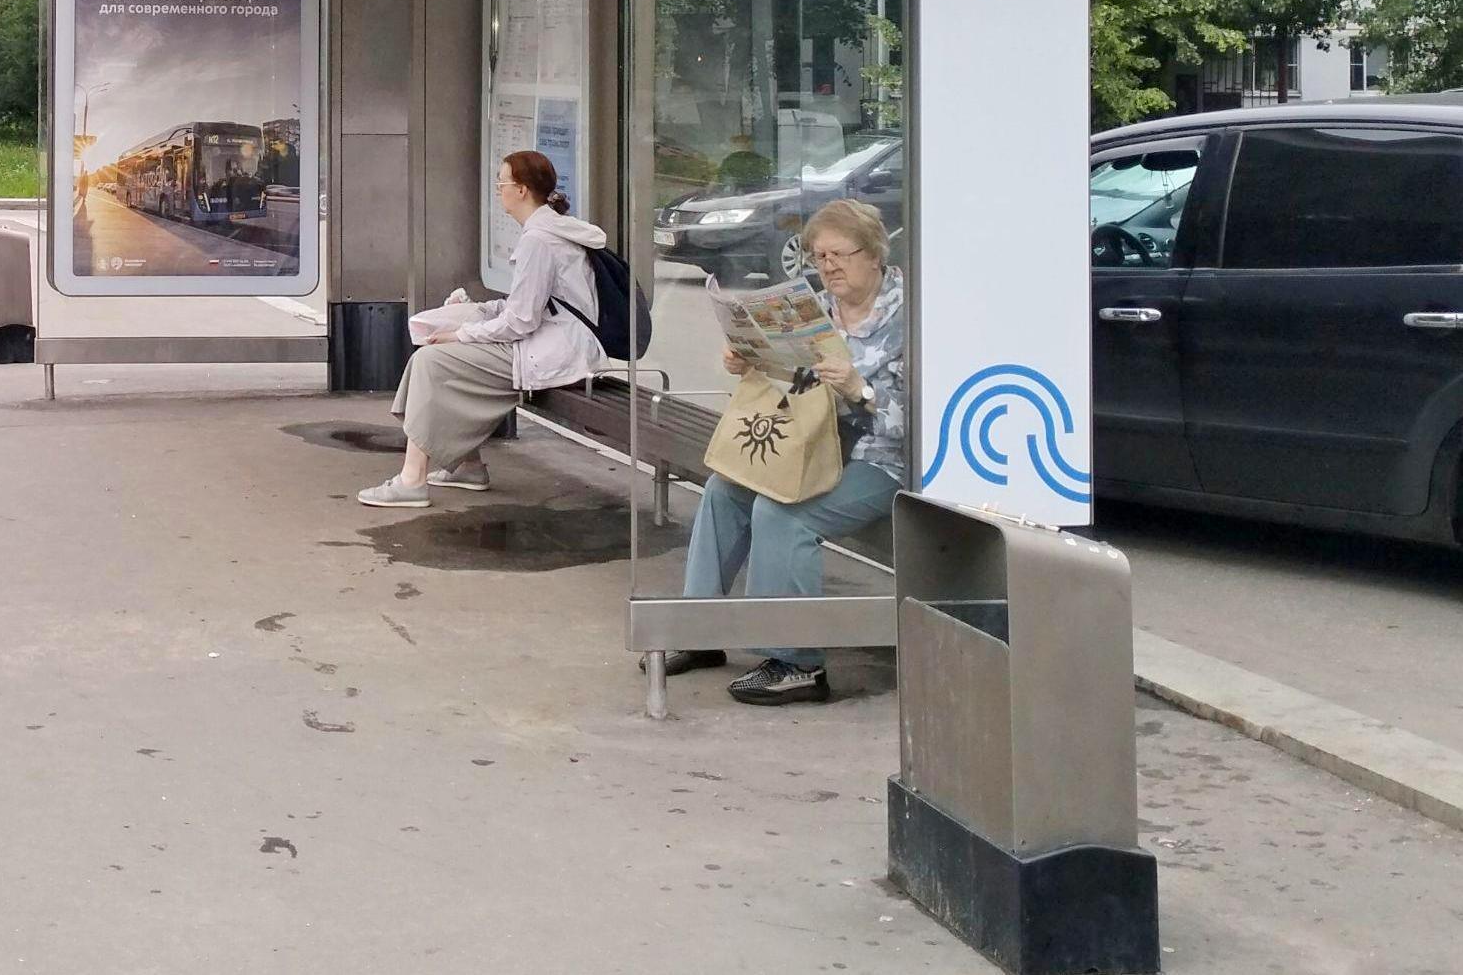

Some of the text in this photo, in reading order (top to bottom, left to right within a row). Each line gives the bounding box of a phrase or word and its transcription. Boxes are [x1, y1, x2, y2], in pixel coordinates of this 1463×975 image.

[99, 3, 279, 17] для современного города
